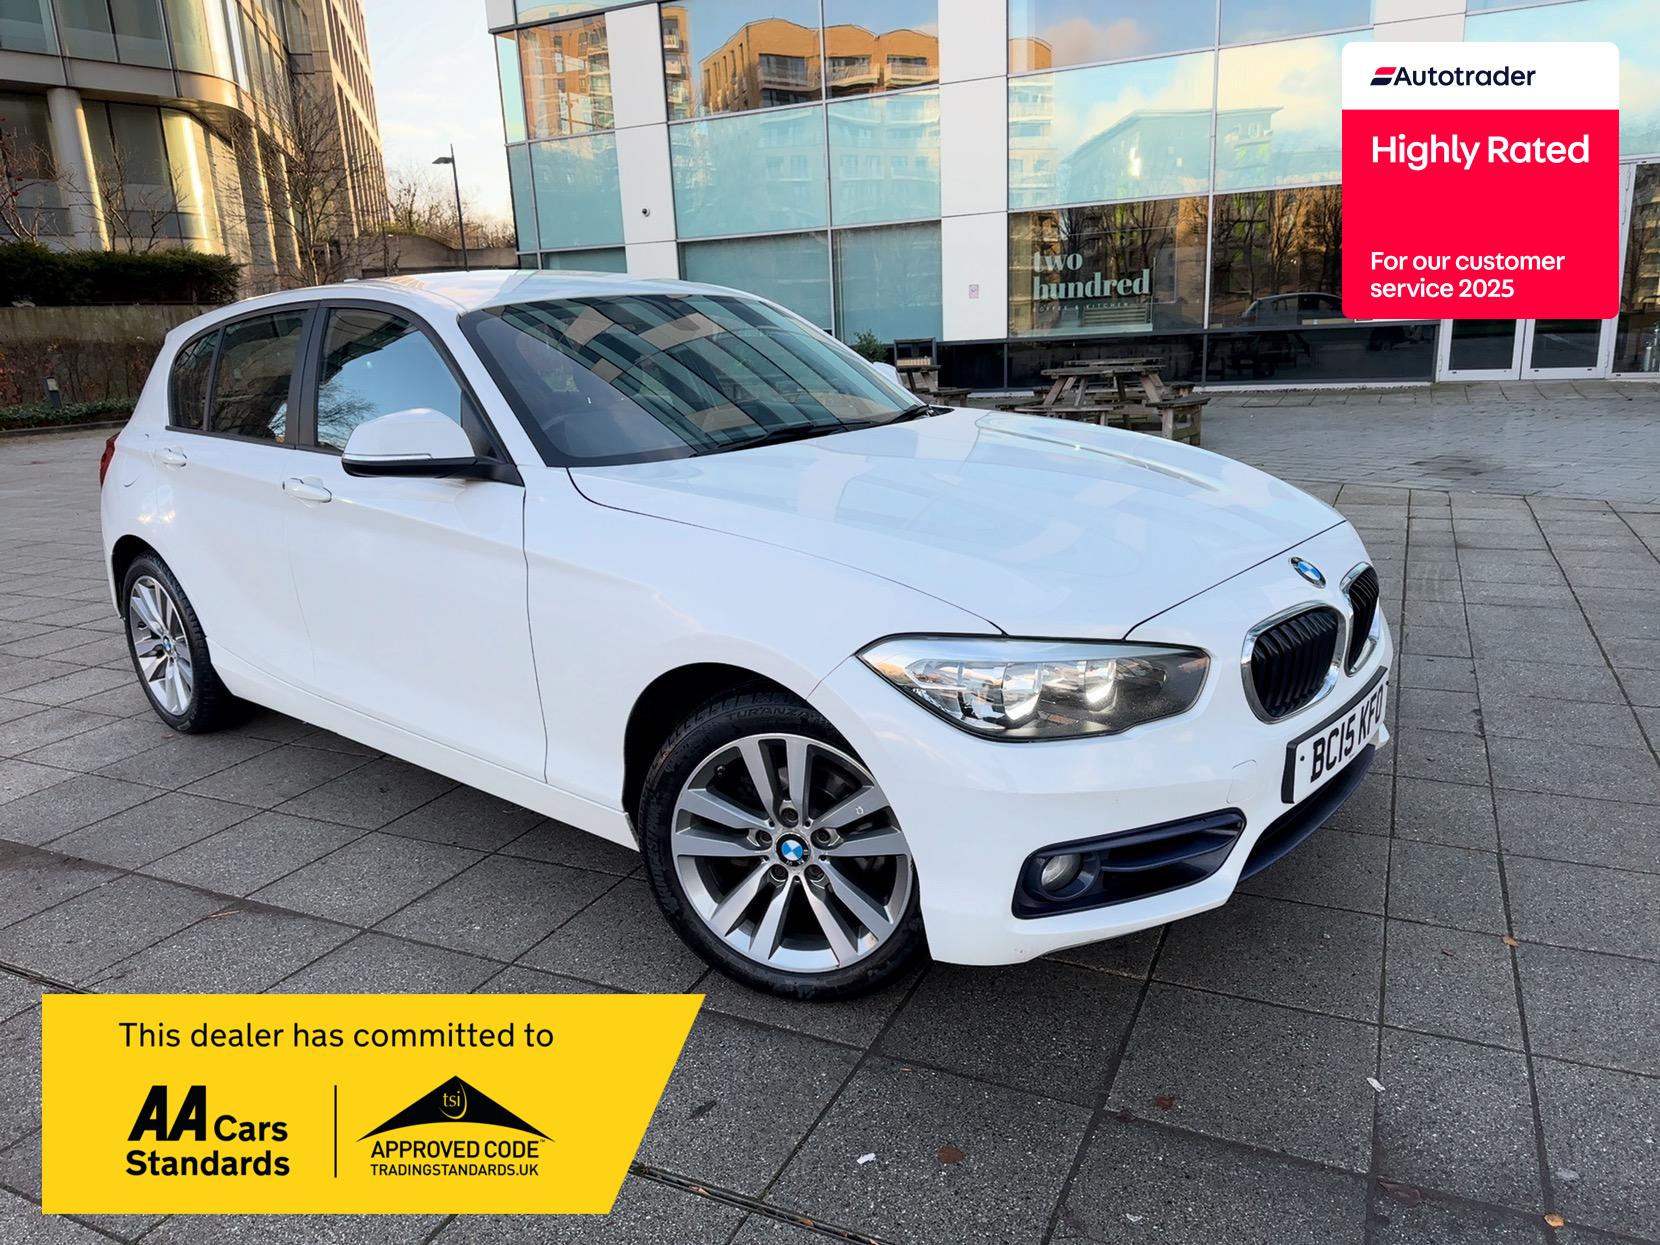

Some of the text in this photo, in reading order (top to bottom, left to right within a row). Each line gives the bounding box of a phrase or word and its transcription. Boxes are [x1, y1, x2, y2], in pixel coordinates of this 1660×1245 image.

[1034, 252, 1083, 272] two
[1033, 268, 1150, 300] hundred
[1310, 713, 1356, 783] BC15
